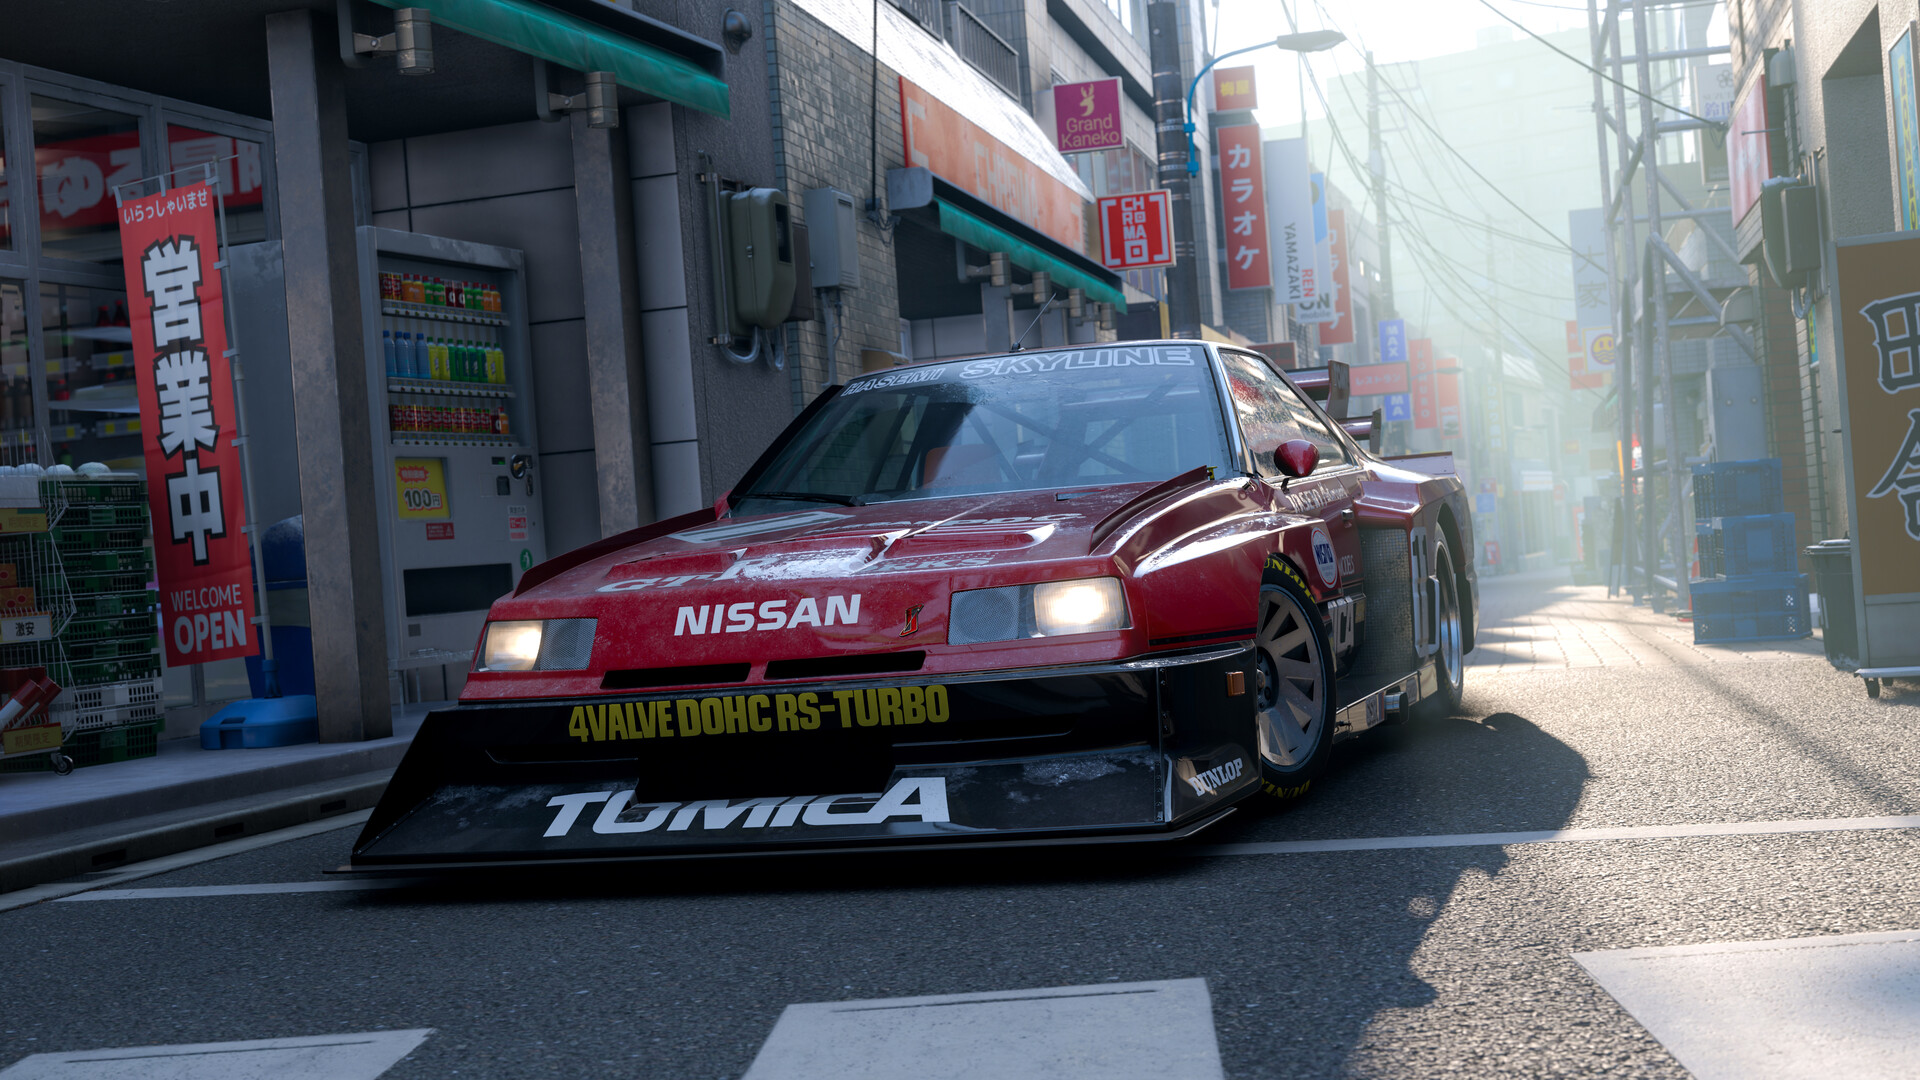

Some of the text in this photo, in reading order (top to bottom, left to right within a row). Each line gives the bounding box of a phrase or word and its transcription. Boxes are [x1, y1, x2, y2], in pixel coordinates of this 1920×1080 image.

[1061, 129, 1120, 149] Kaneko
[1066, 113, 1113, 133] Grand
[123, 188, 208, 224] いらっしゃいませ
[1228, 143, 1260, 270] カラオケ
[1283, 222, 1302, 299] YAMAZAKI
[1300, 268, 1316, 298] REN
[1384, 324, 1399, 357] MAX
[840, 346, 1196, 398] HASEMI SKYLINE
[1355, 374, 1401, 386] レストラン
[142, 237, 227, 565] 営業中
[404, 489, 441, 508] 100円
[170, 584, 242, 612] WELCOME
[1264, 557, 1316, 604] UNLOP
[15, 622, 35, 637] 激安
[174, 609, 247, 655] OPEN
[674, 593, 862, 637] NISSAN
[568, 684, 950, 743] 4VALVE DOHC RS-TURBO
[1188, 757, 1244, 798] DUNLOP
[542, 776, 951, 838] TOMICA
